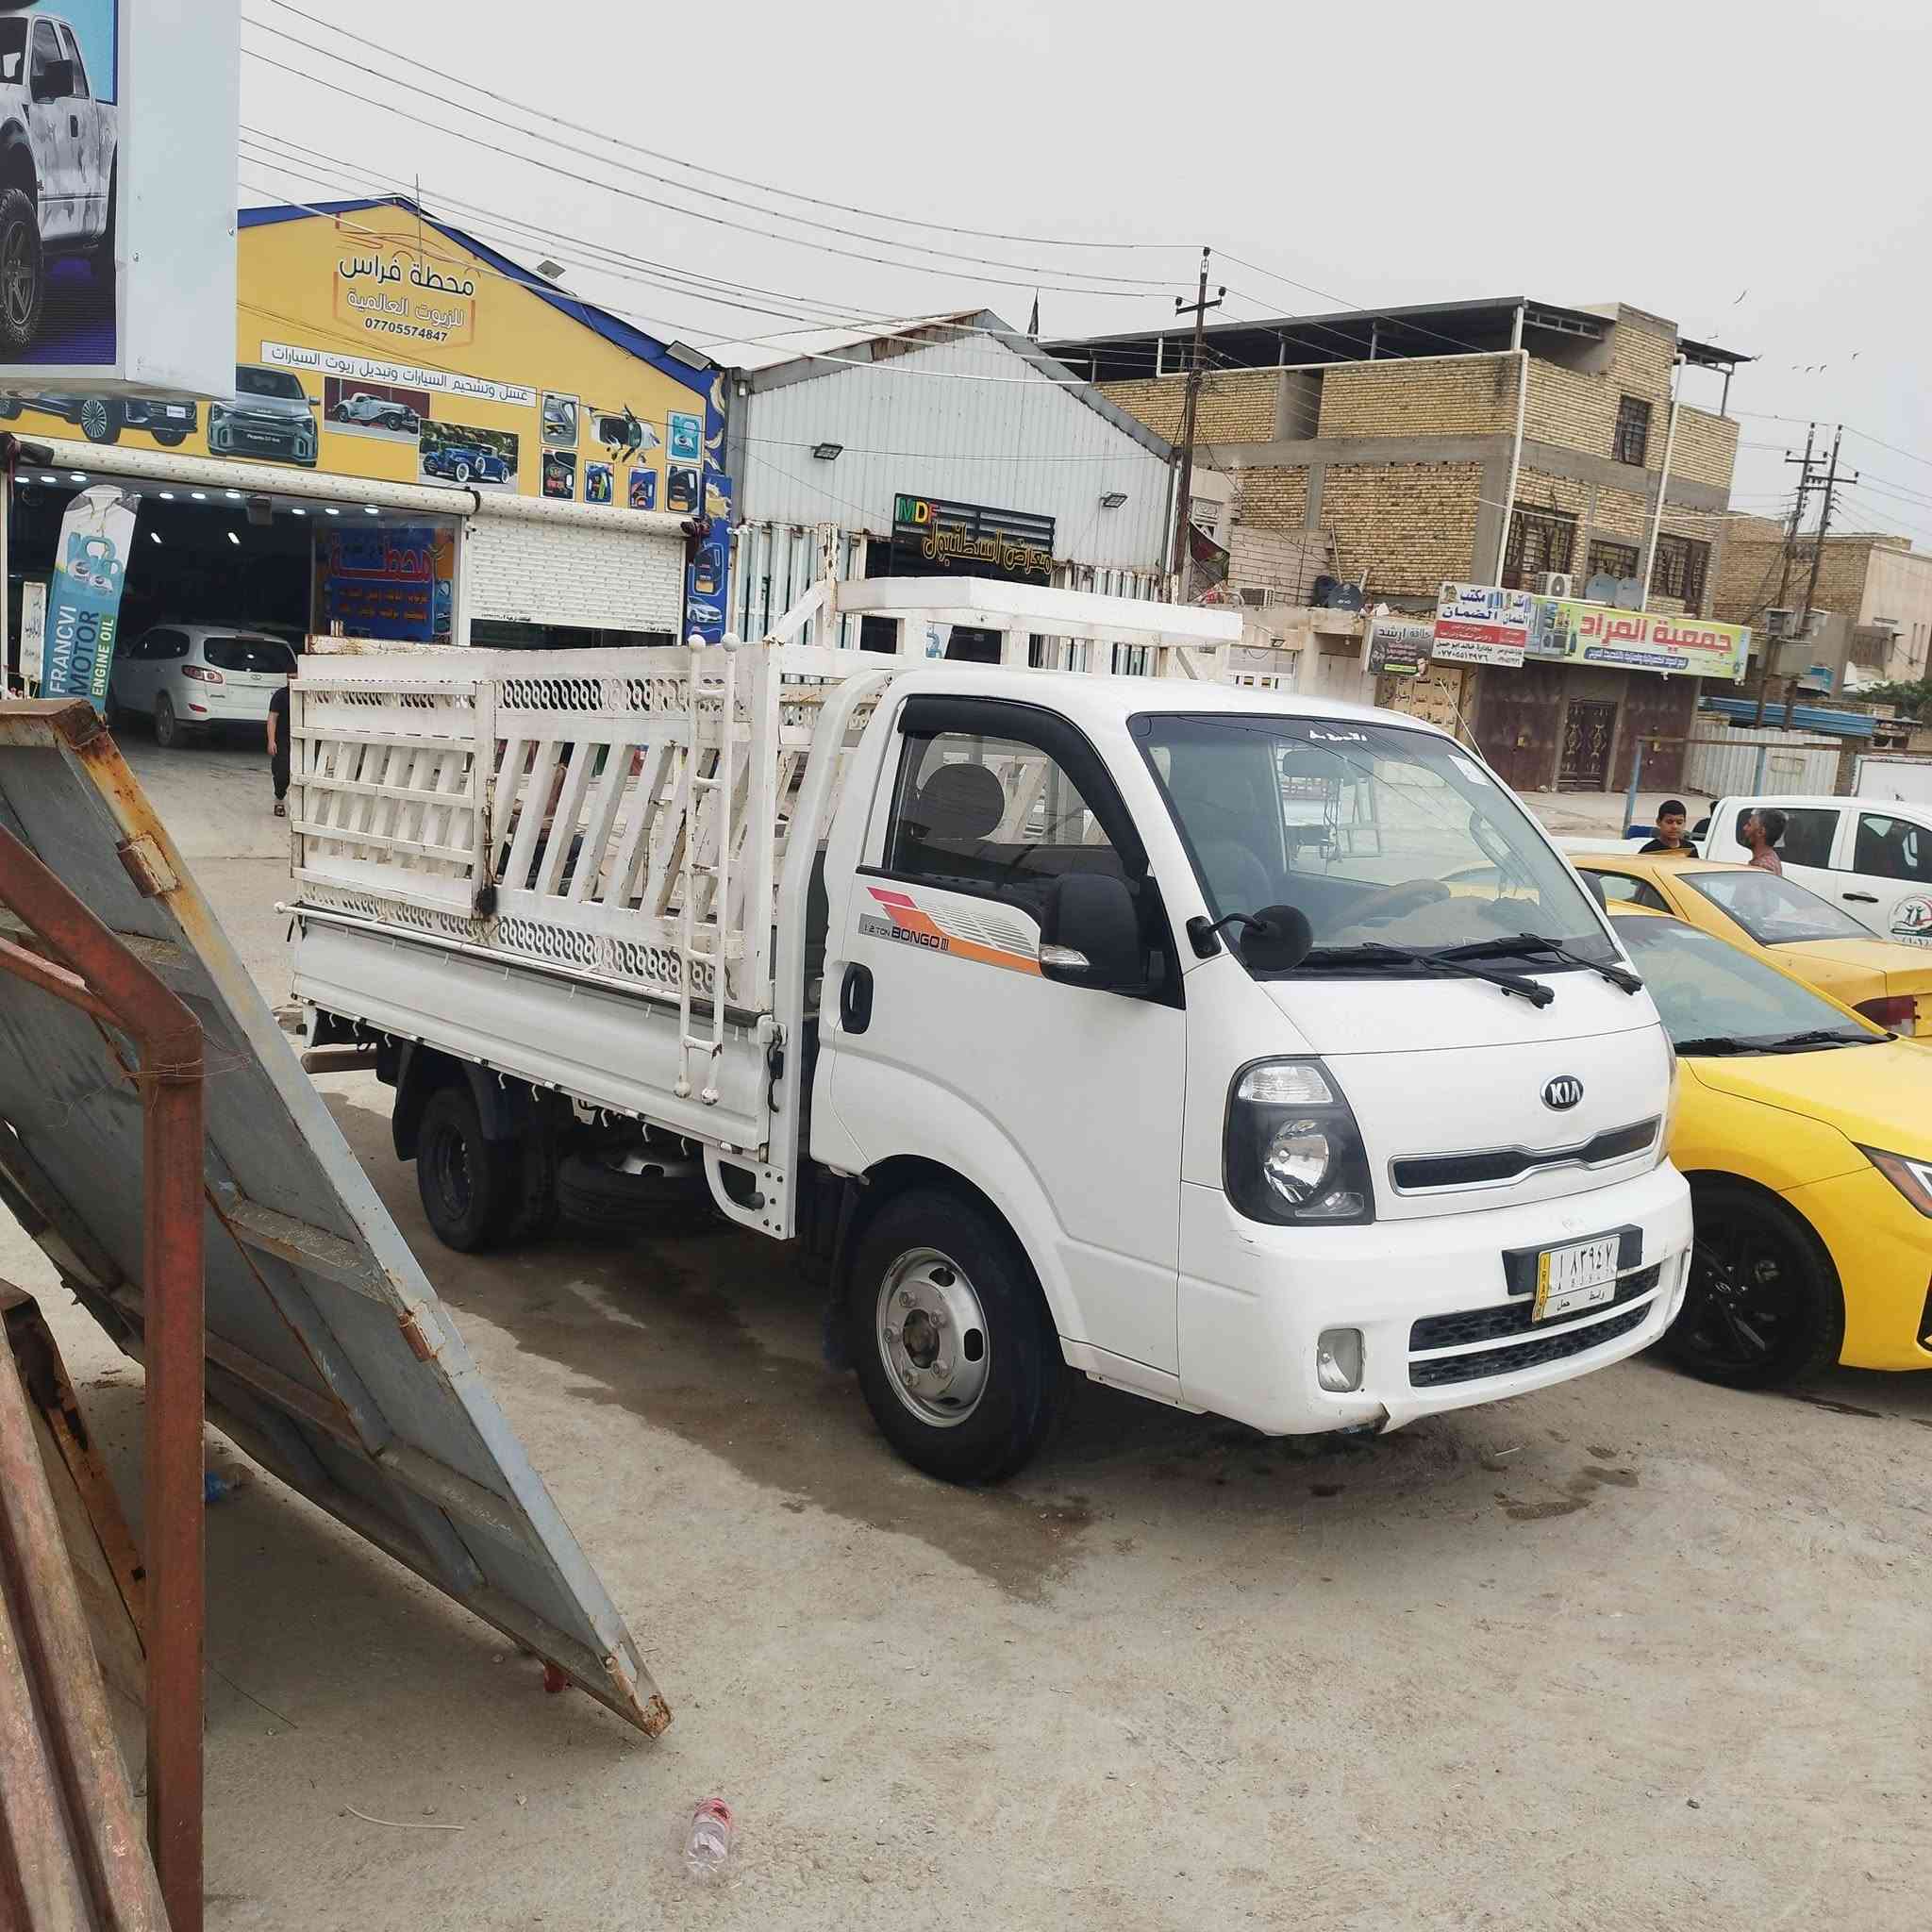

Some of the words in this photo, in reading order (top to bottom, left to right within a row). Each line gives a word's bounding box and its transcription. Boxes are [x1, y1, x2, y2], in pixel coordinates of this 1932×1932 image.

[339, 255, 402, 285] فراس
[409, 263, 475, 296] محطة
[347, 288, 409, 317] العالمية
[415, 302, 465, 329] للزيوت
[365, 317, 448, 342] 07705574847
[272, 347, 321, 366] السيارات
[359, 362, 398, 381] وتبديل
[403, 368, 447, 388] السيارات
[897, 497, 939, 524] MDF
[922, 520, 1003, 567] اسطنبول
[1004, 538, 1053, 575] معارض
[1460, 589, 1486, 605] مكتب
[1442, 606, 1498, 620] الضمان
[100, 619, 114, 641] OIL
[1579, 613, 1647, 646] المراد
[1654, 619, 1733, 657] جمعية
[50, 605, 76, 693] FRANCVI
[67, 610, 99, 696] MOTOR
[92, 644, 109, 696] ENGINE
[874, 926, 891, 937] TON
[891, 925, 941, 948] BONGO
[1550, 1080, 1582, 1105] KIA
